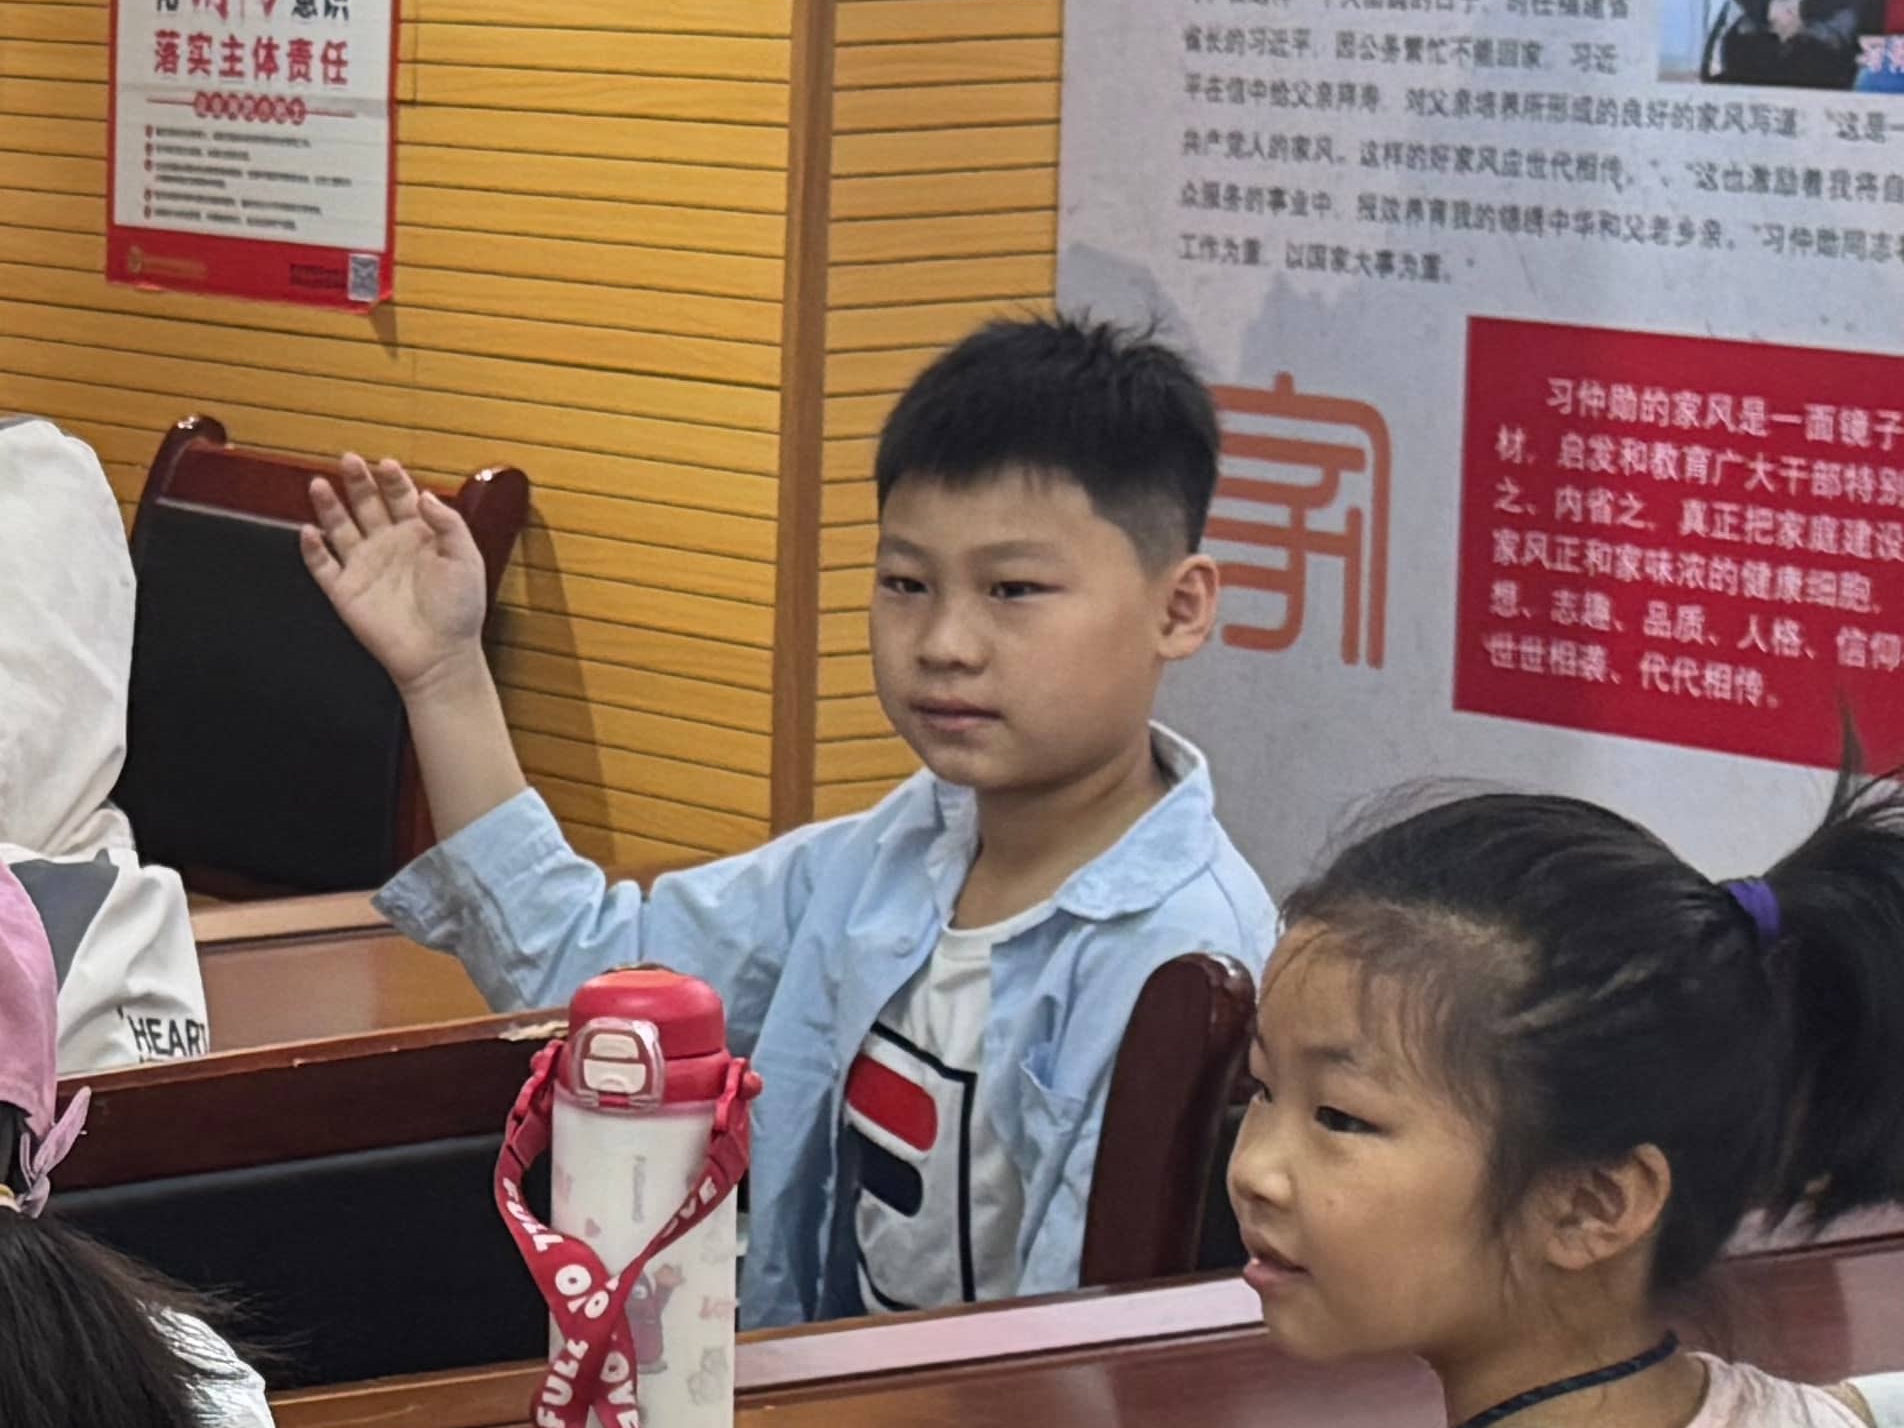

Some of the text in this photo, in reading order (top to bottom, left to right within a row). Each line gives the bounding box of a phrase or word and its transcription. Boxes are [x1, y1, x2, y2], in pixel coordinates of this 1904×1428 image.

[153, 30, 349, 86] 落实主体责任
[1545, 376, 1904, 452] 习仲勋的家风是一面镜子
